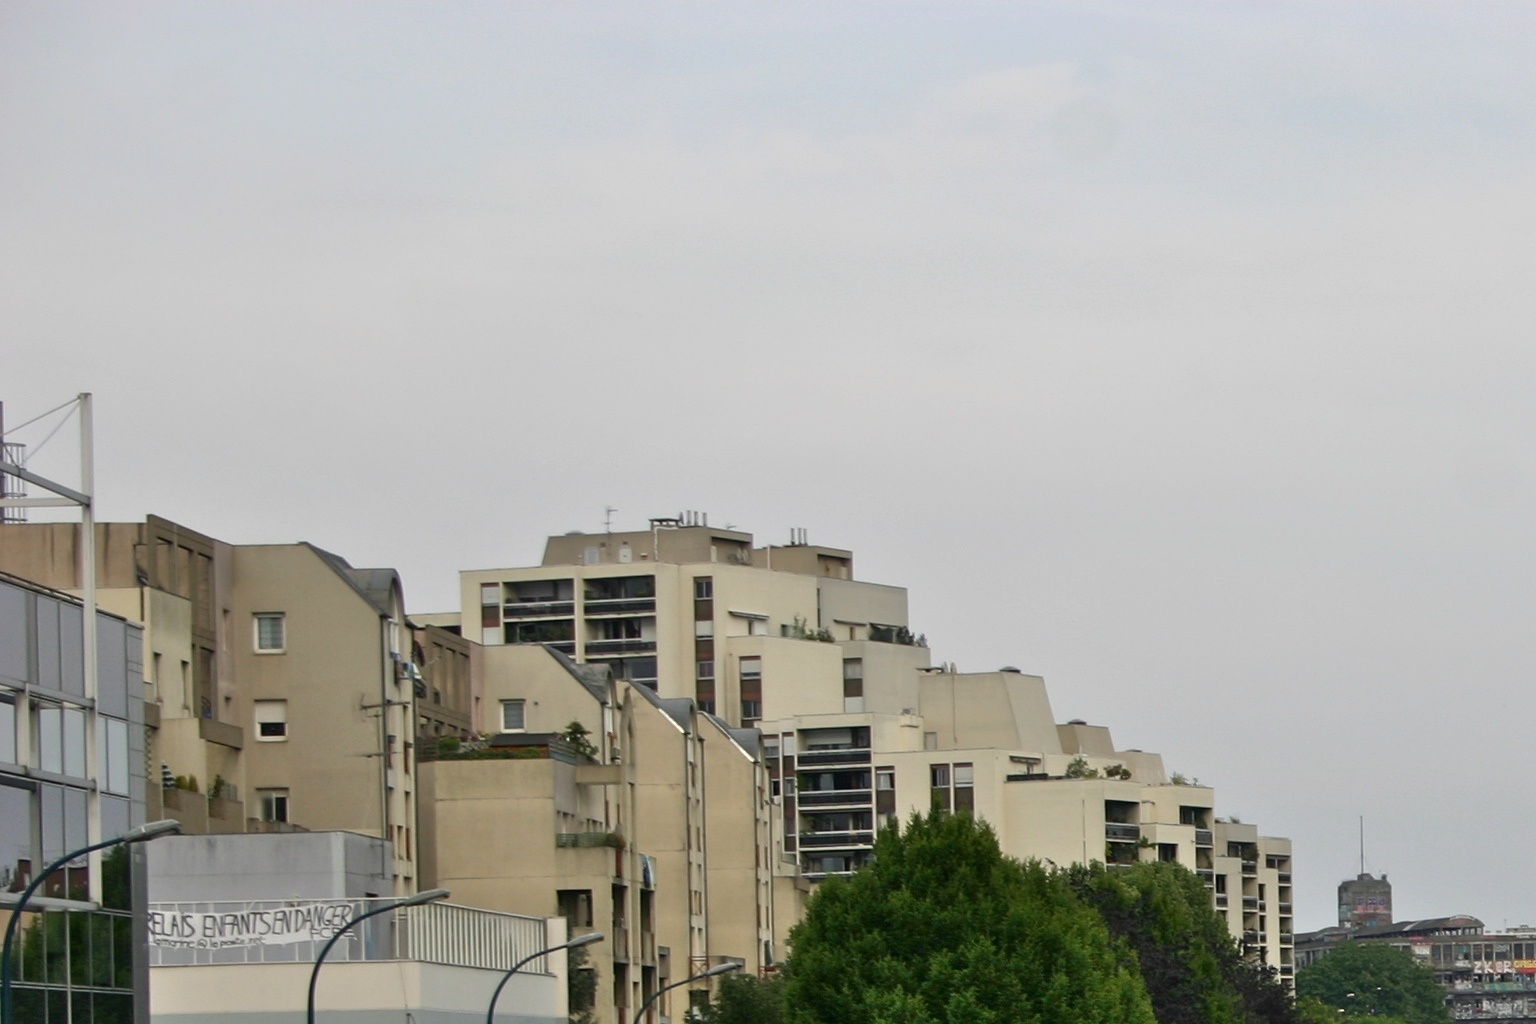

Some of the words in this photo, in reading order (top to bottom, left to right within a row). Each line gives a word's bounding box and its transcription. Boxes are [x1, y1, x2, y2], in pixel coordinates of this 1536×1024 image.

[203, 911, 271, 938] ENFANTS
[272, 909, 291, 935] EN
[294, 904, 352, 933] DANGER
